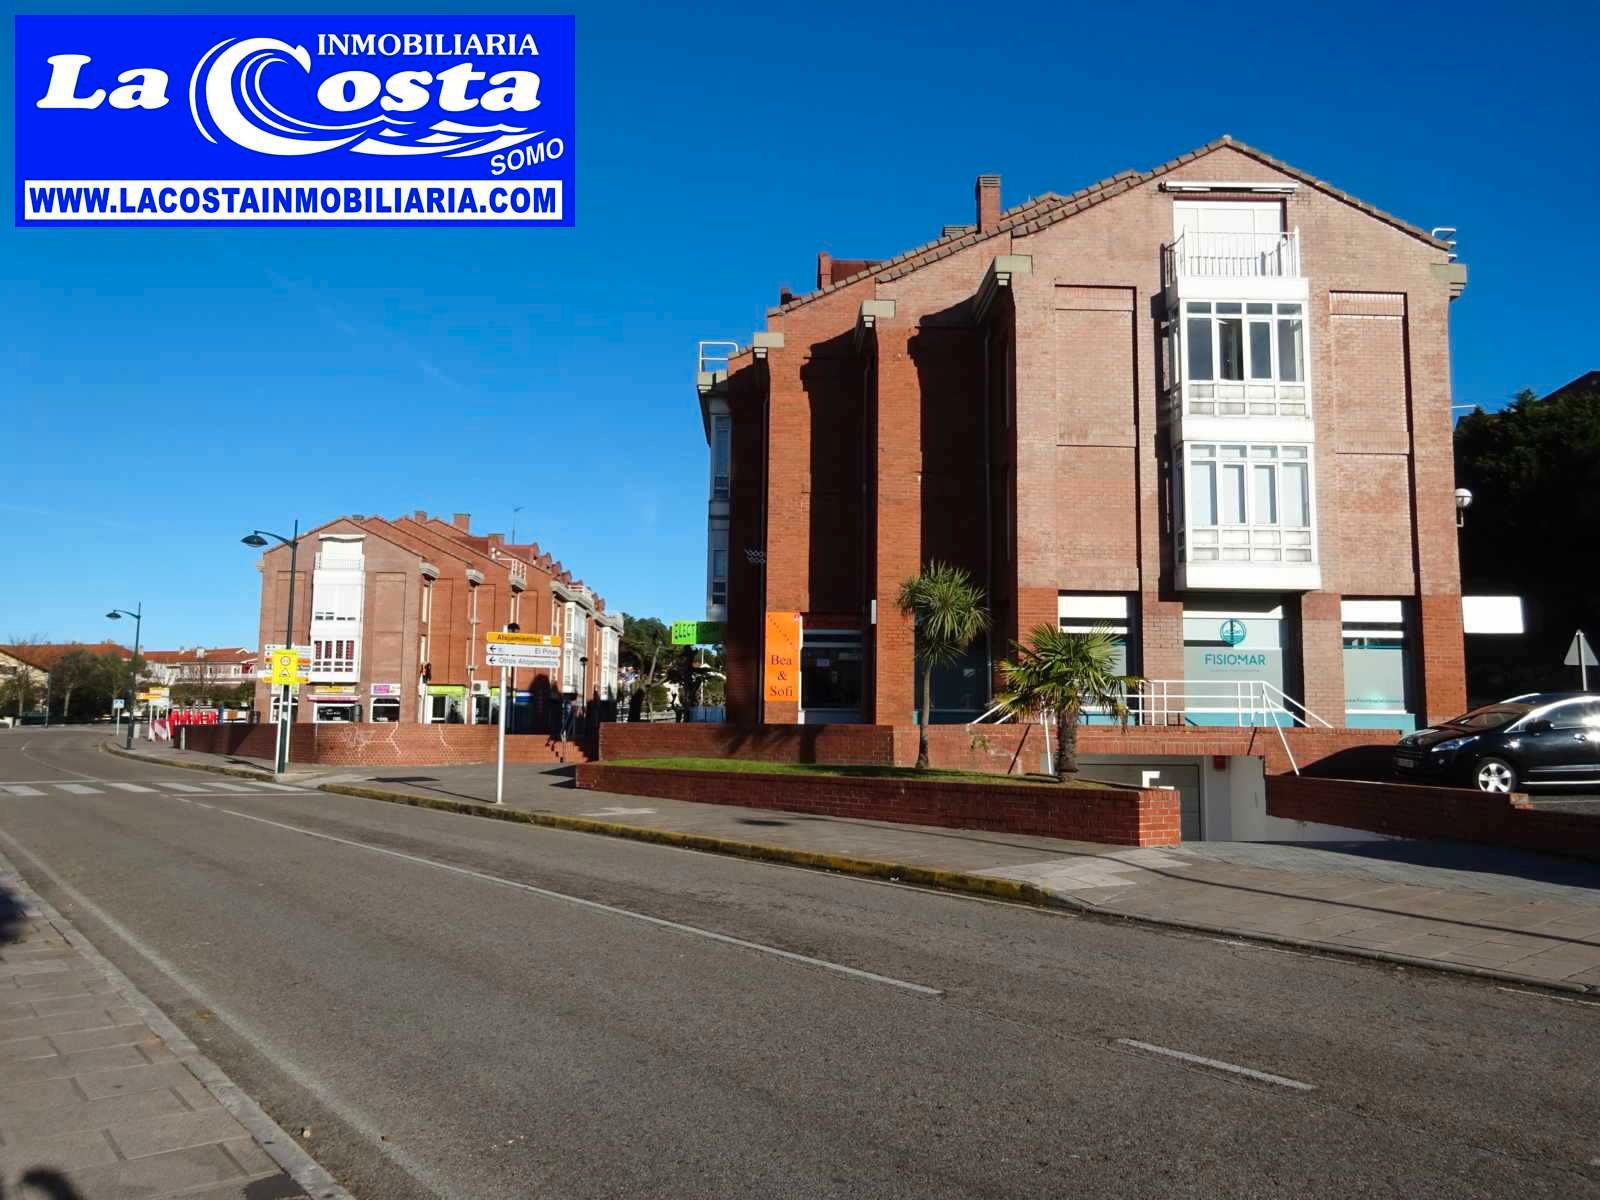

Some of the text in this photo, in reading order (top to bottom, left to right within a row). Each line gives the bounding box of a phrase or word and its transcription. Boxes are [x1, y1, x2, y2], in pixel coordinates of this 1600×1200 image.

[770, 654, 793, 665] Bea
[1204, 653, 1266, 666] FISIOMAR
[777, 671, 787, 681] &
[769, 685, 793, 697] Sofi
